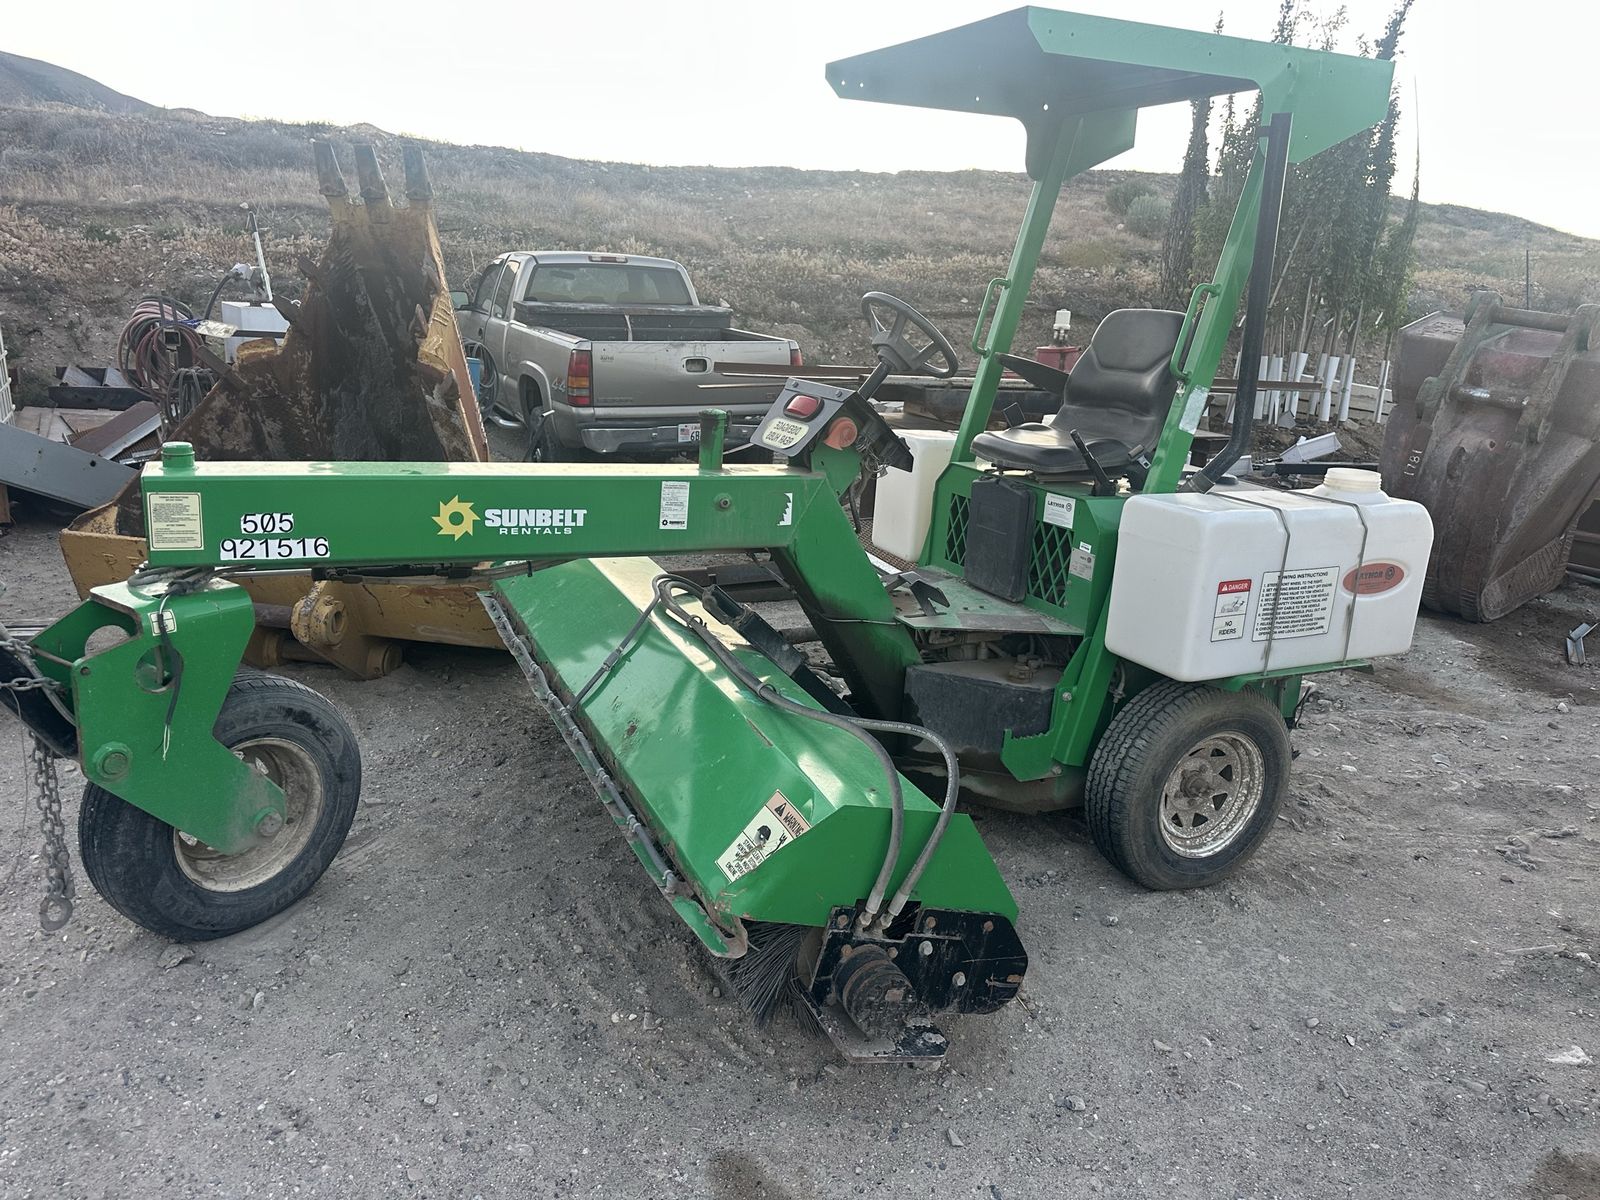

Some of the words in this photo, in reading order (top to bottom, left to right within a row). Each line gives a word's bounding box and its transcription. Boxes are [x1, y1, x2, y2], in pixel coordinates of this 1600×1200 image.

[484, 508, 588, 527] SUNBELT
[499, 527, 573, 535] RENTALS
[221, 537, 329, 559] 921516
[1228, 582, 1249, 591] DANGER
[1218, 627, 1237, 636] RIDERS
